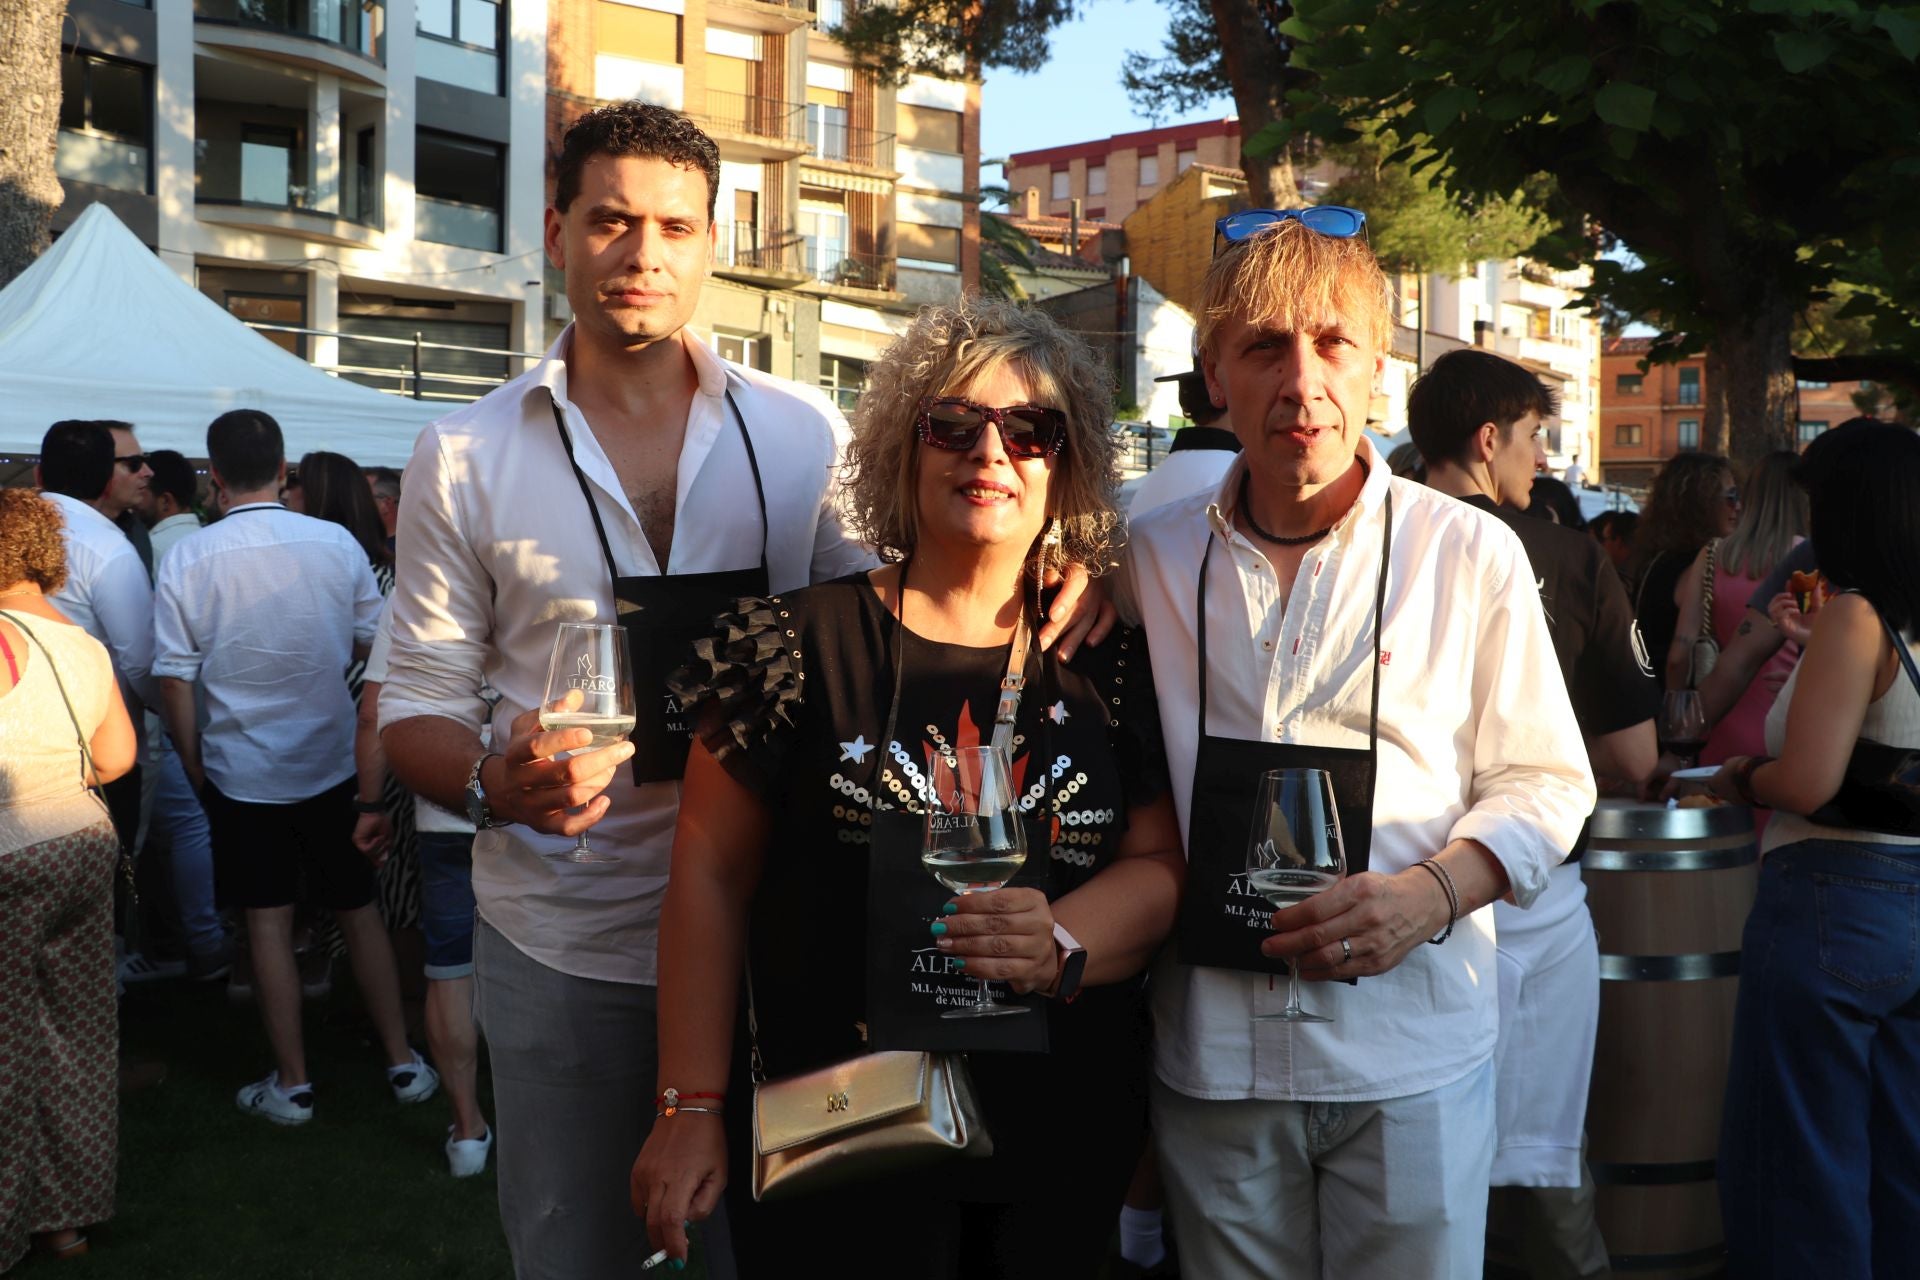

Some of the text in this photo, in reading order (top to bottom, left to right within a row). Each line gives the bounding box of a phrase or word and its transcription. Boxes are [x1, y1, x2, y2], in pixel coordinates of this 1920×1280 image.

[1226, 879, 1264, 898] AL
[1224, 904, 1246, 917] M.I.
[1247, 918, 1260, 928] de
[910, 954, 958, 975] ALF
[911, 982, 1006, 999] M.I. Ayuntamnto
[935, 995, 977, 1008] de Alfar
